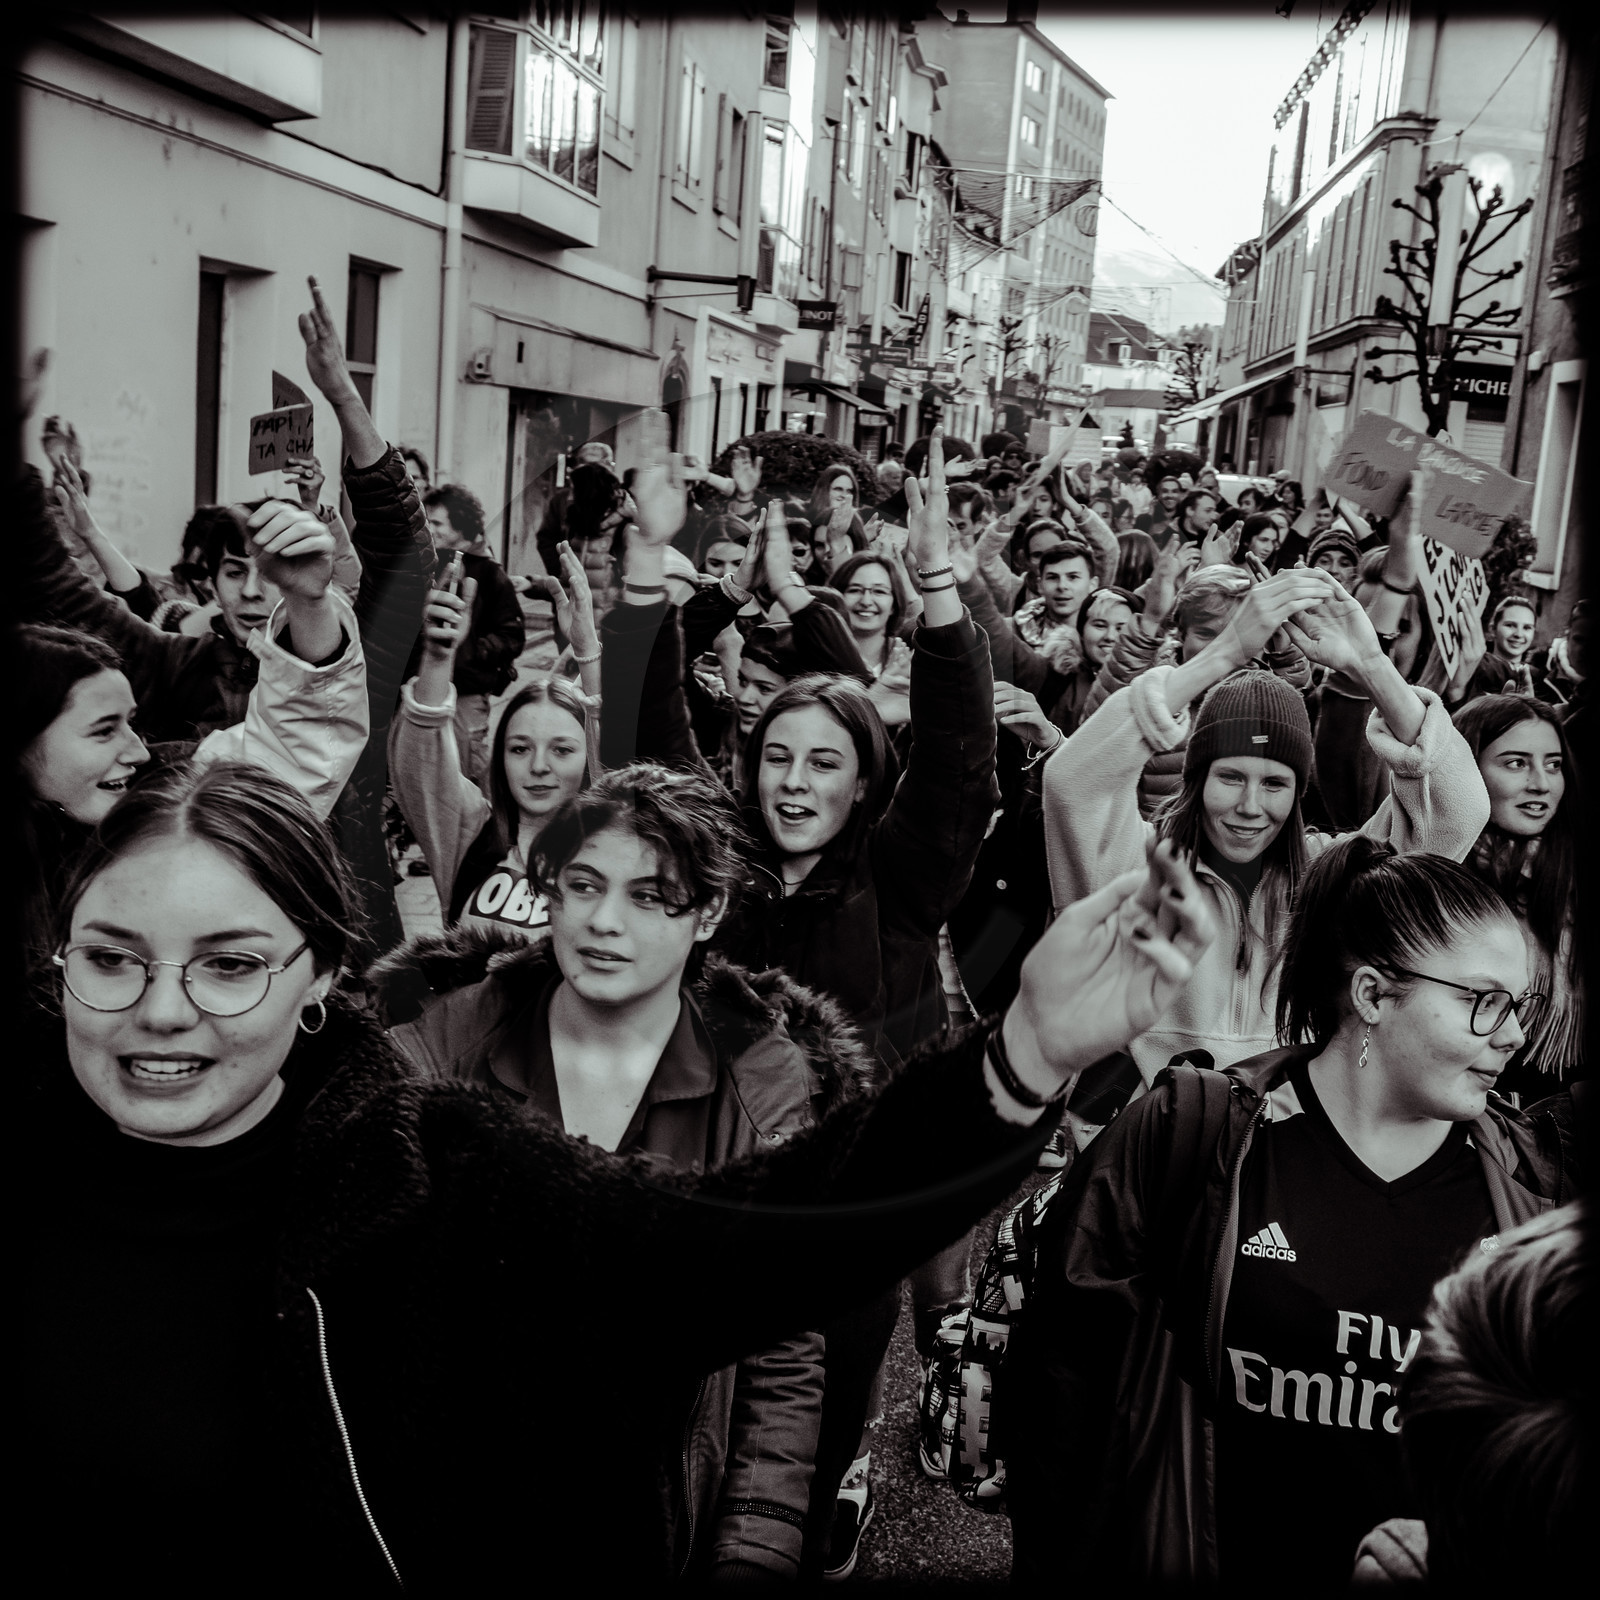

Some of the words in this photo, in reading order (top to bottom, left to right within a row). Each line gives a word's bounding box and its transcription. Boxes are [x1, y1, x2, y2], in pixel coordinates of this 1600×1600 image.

[255, 441, 276, 460] TA
[1241, 1243, 1297, 1262] adidas
[1336, 1309, 1422, 1373] Fly
